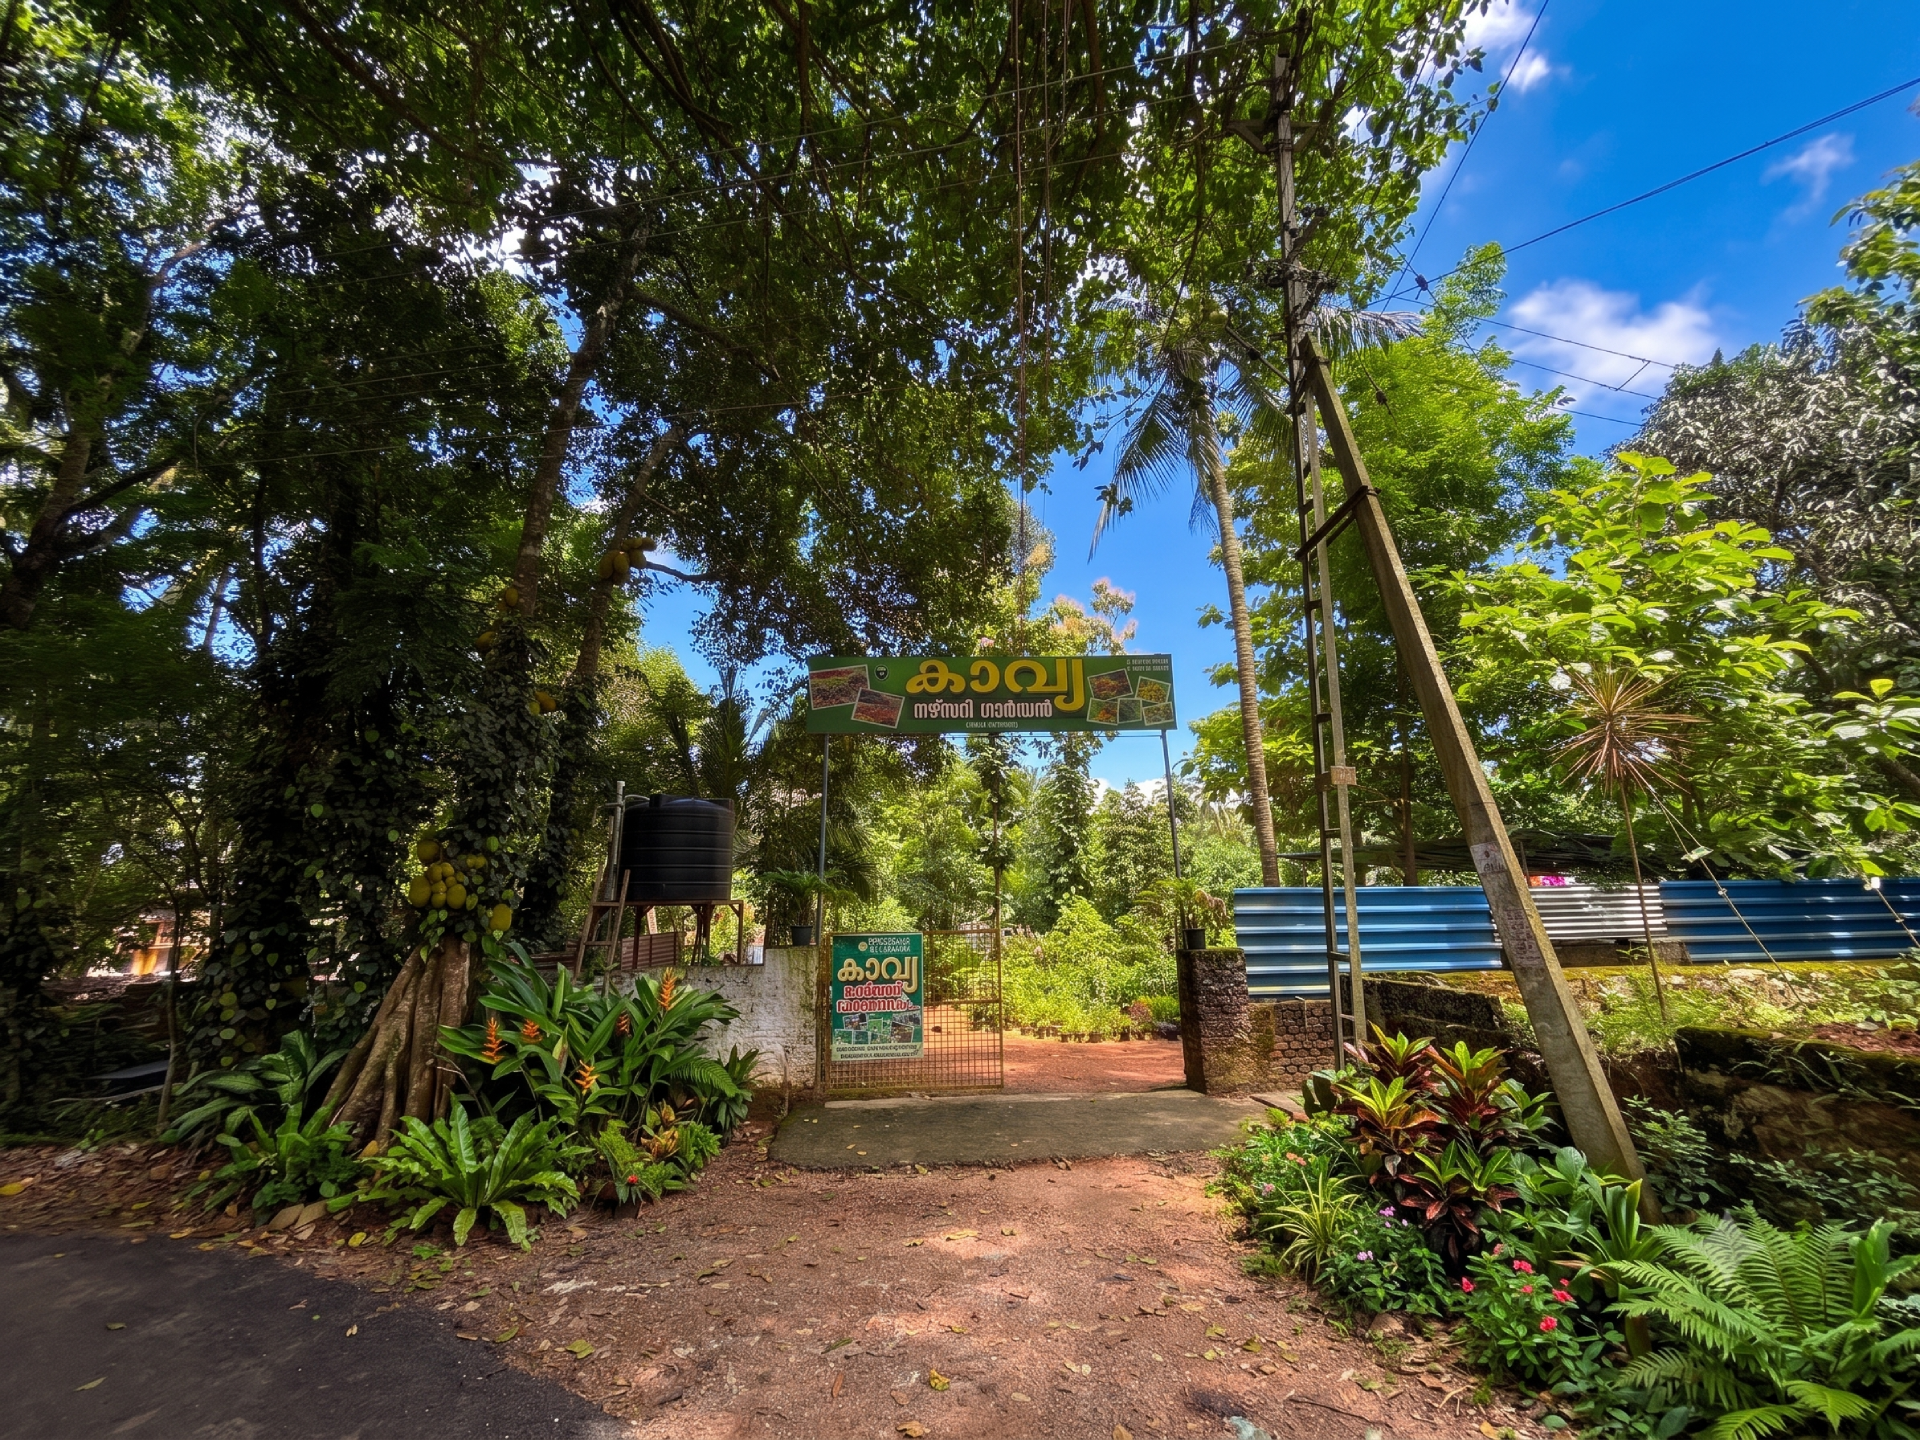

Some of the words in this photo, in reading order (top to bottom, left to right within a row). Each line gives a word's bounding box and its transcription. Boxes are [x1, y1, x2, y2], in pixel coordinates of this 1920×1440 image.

[905, 658, 1085, 712] കാവ്യ
[914, 699, 974, 719] നഴ്സറി
[837, 956, 919, 993] കാവ്യ
